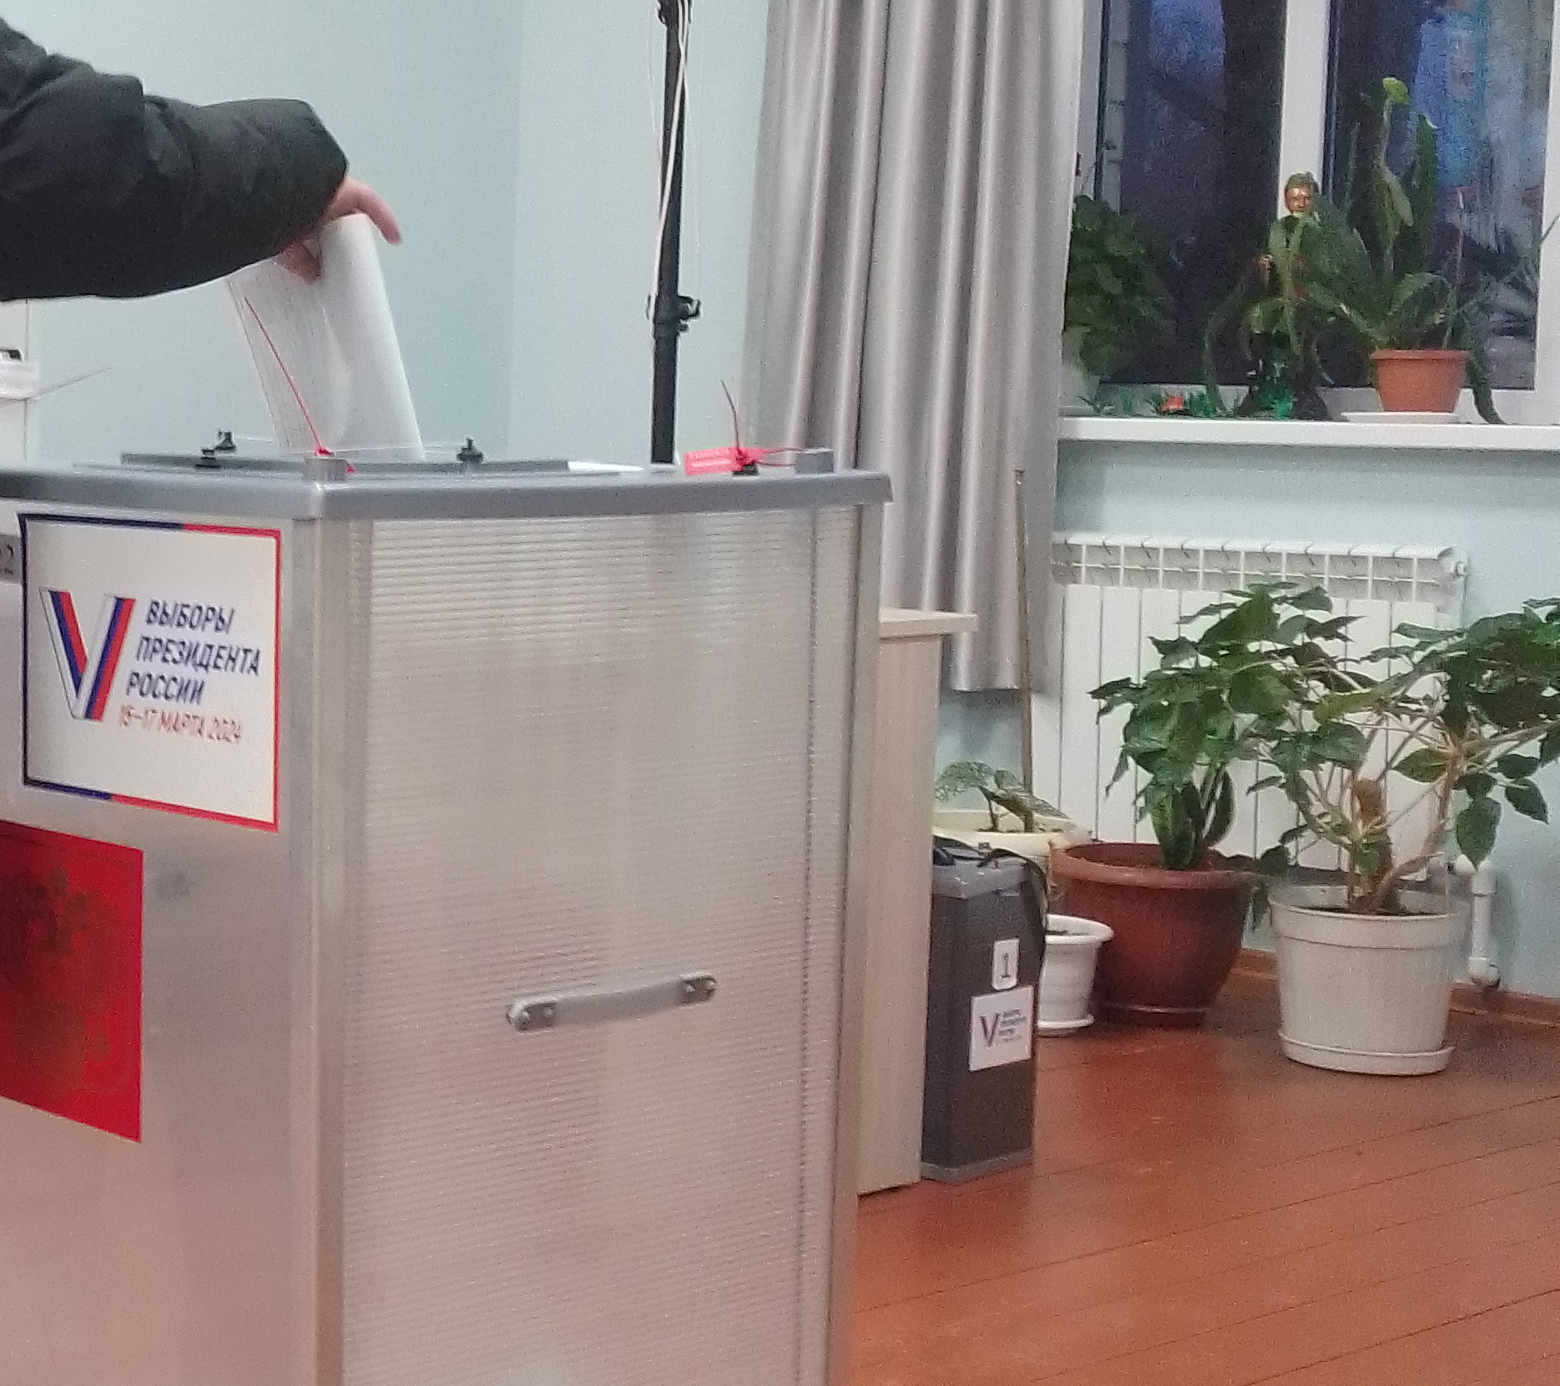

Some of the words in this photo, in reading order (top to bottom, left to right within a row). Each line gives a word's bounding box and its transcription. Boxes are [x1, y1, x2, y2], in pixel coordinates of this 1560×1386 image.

[145, 598, 235, 635] ВЫБОРЫ
[136, 634, 262, 677] ПРЕЗИДЕНТА
[125, 669, 205, 705] РОССИИ
[158, 708, 206, 737] МАРТА
[1000, 952, 1012, 979] 1
